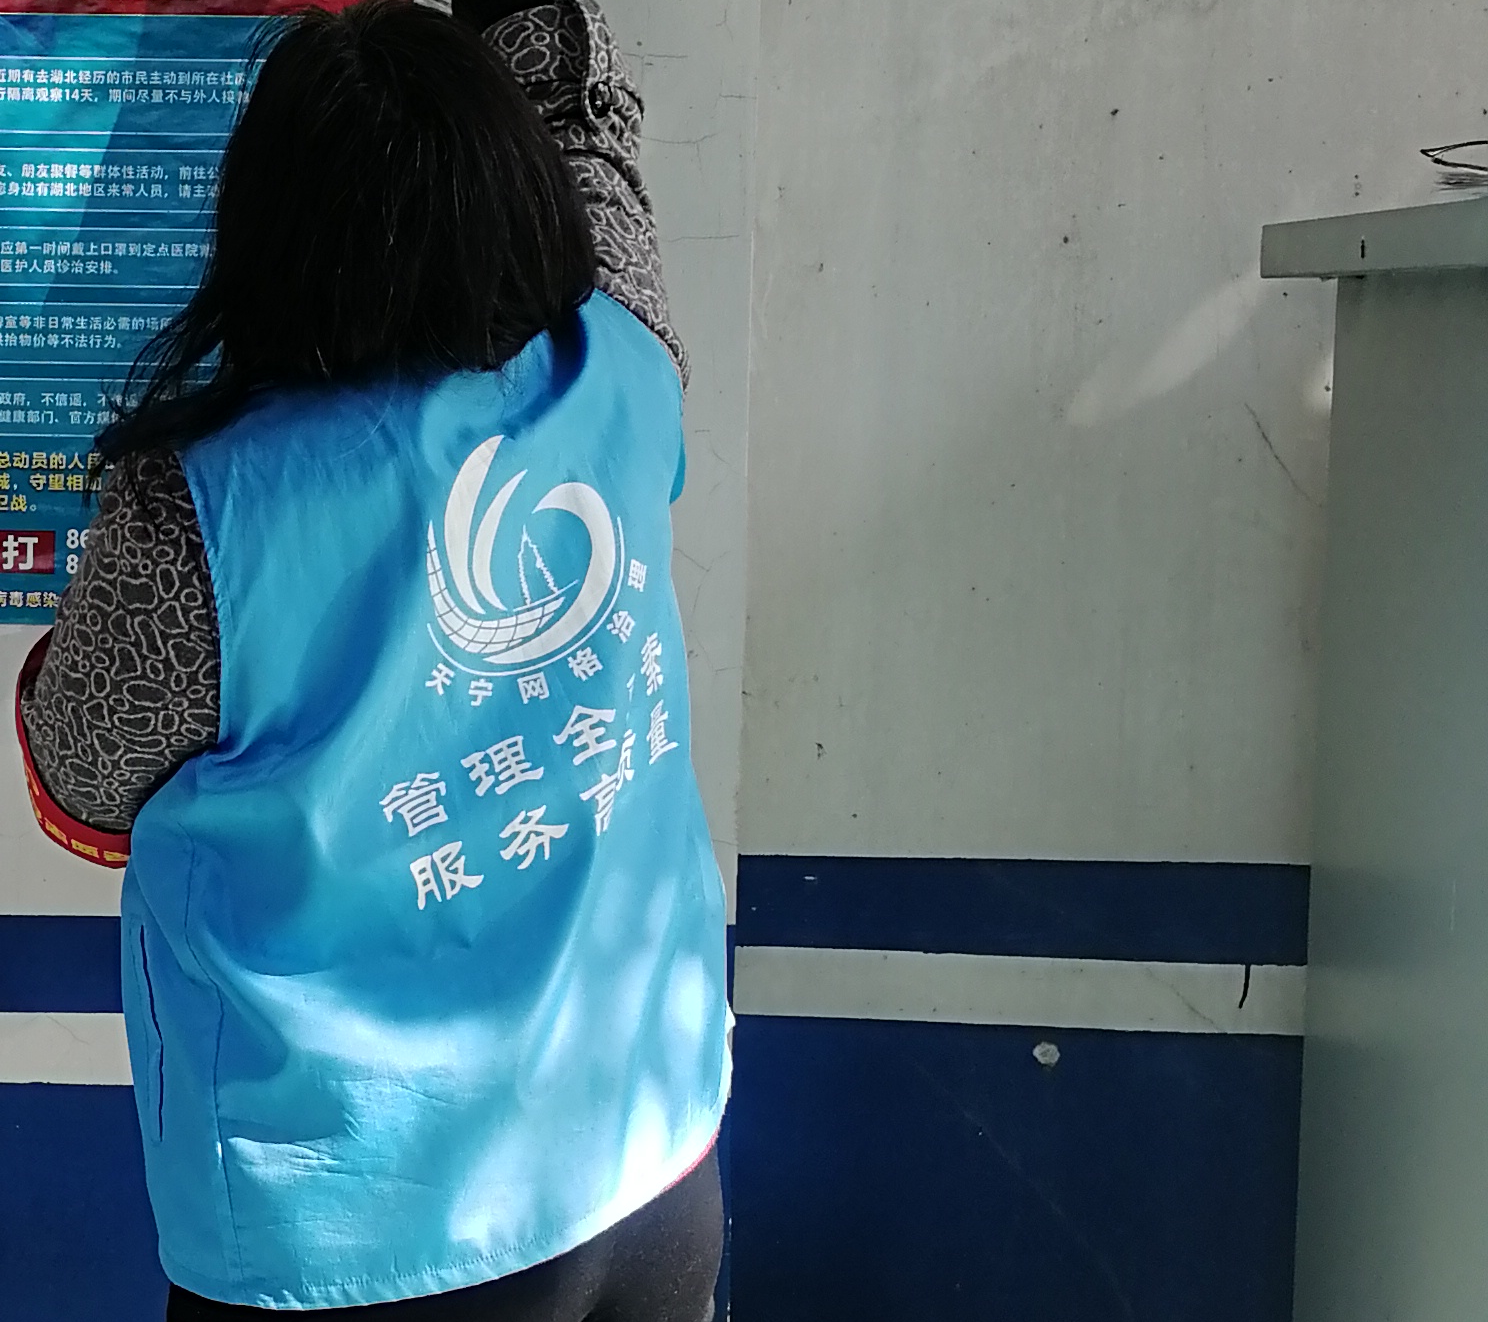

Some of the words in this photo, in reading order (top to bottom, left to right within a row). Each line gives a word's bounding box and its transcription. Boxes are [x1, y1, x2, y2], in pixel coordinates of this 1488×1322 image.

[425, 558, 648, 706] 天宁网格治理
[379, 631, 664, 836] 管理全素
